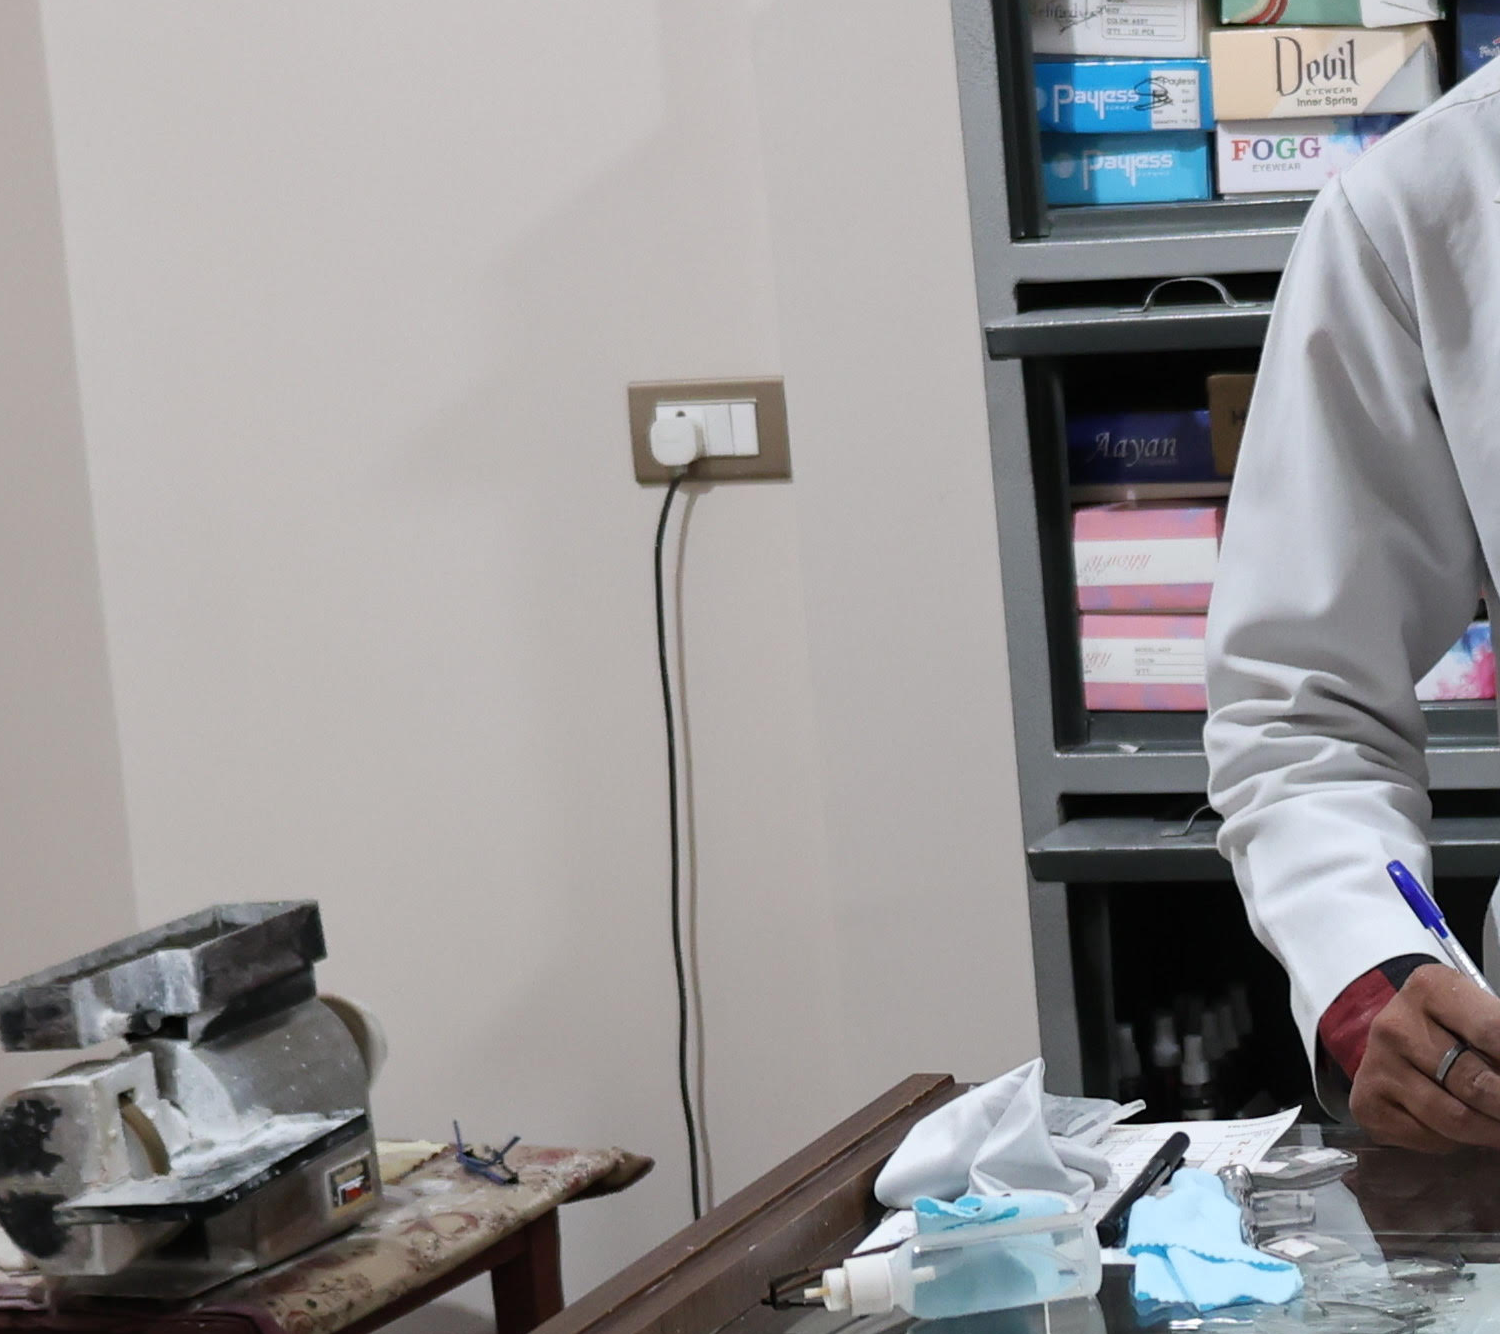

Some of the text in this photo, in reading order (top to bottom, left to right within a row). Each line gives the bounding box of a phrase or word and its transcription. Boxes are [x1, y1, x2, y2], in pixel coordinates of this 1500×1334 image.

[1273, 35, 1362, 97] Devil
[1053, 84, 1140, 123] Payless
[1296, 95, 1358, 108] Inner Spring
[1305, 86, 1353, 96] EYEWEAR
[1231, 136, 1322, 161] FOGG
[1083, 149, 1173, 191] Payless
[1252, 162, 1301, 173] EYEWEAR
[1086, 430, 1178, 468] Aayan
